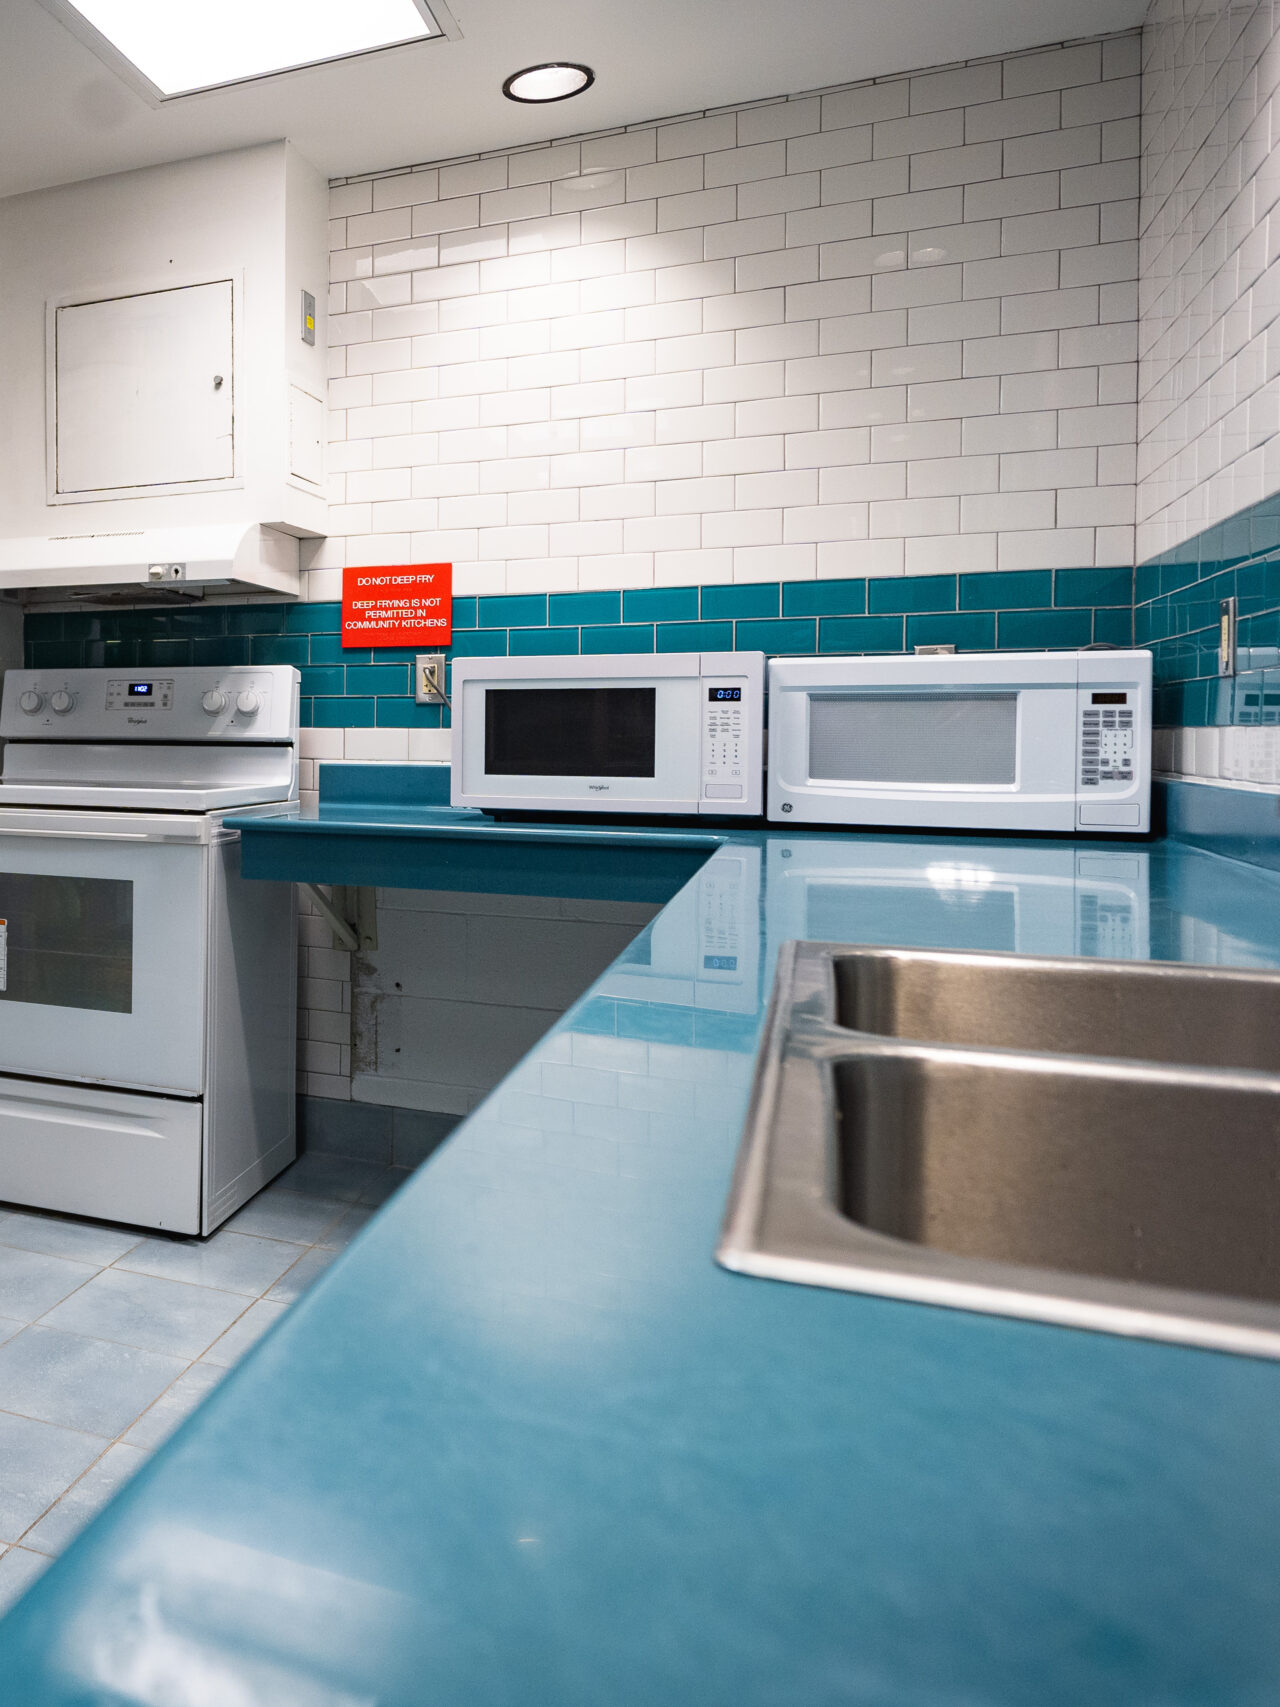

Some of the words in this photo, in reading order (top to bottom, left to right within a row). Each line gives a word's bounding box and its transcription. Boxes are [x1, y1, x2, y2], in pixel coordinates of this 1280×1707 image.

[357, 577, 371, 586] DO
[372, 576, 391, 585] NOT
[392, 575, 416, 584] DEEP
[417, 574, 435, 583] FRY
[352, 601, 375, 609] DEEP
[377, 599, 410, 608] FRYING
[411, 598, 420, 607] IS
[421, 598, 441, 606] NOT
[365, 609, 415, 619] PERMITTED
[417, 609, 426, 617] IN
[345, 620, 400, 629] COMMUNITY
[401, 618, 447, 628] KITCHENS
[717, 690, 740, 699] 0:00
